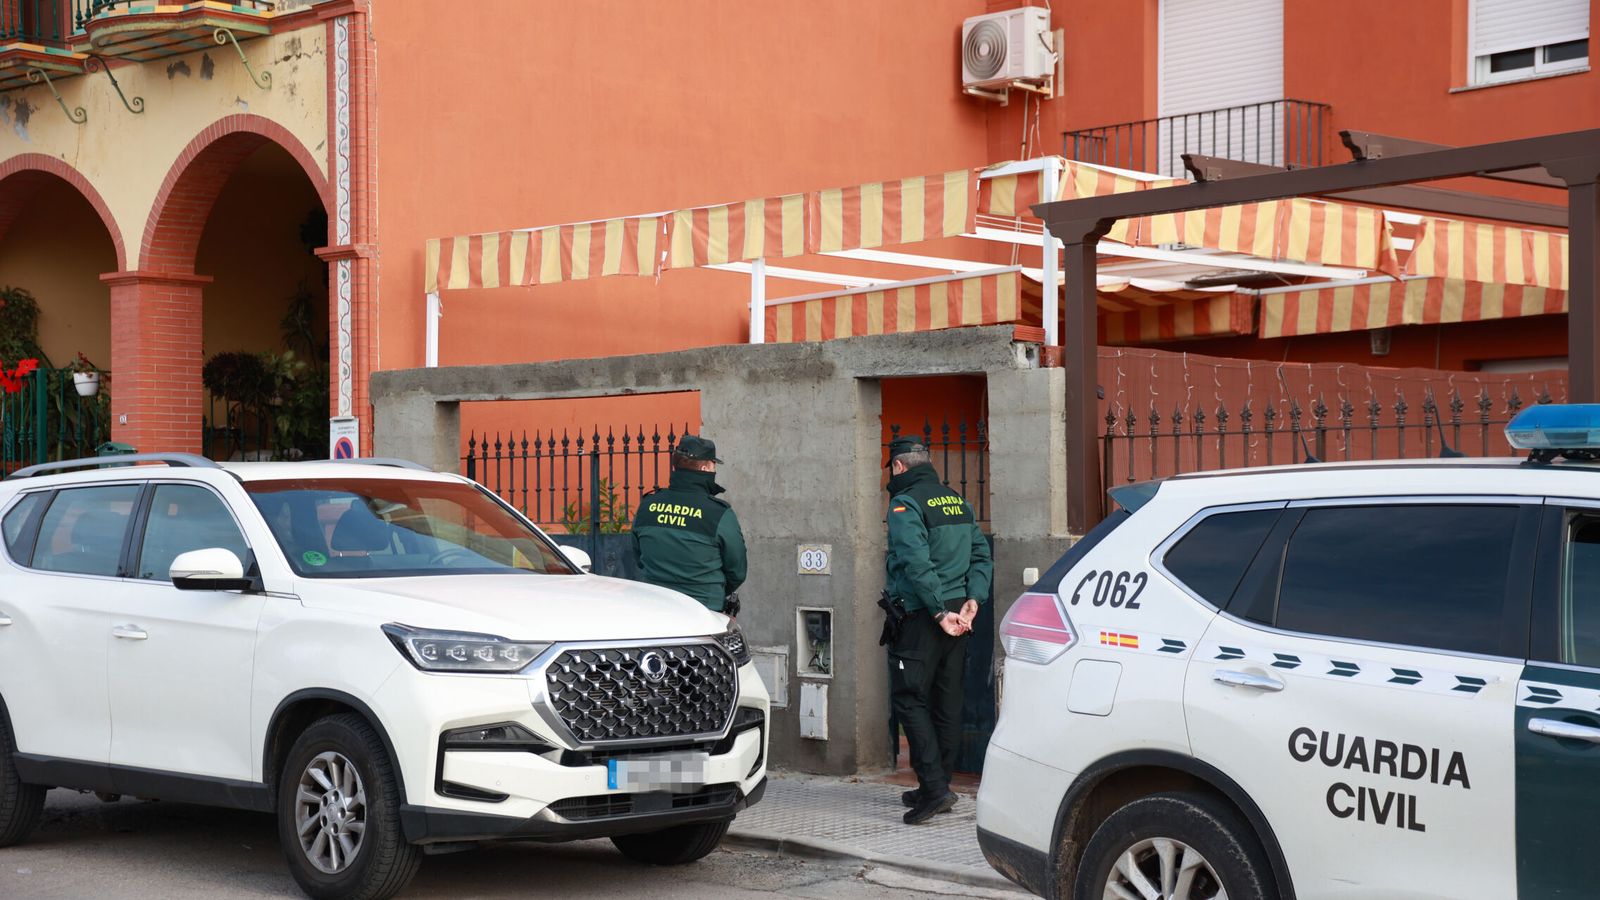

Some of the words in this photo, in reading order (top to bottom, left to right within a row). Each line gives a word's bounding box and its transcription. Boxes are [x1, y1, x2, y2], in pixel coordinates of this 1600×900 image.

[648, 502, 703, 519] GUARDIA
[942, 505, 964, 516] CVIL
[657, 513, 687, 527] CIVIL
[805, 552, 822, 568] 33
[1092, 570, 1148, 610] 062
[1288, 726, 1471, 790] GUARDIA
[1326, 782, 1426, 833] CIVIL
